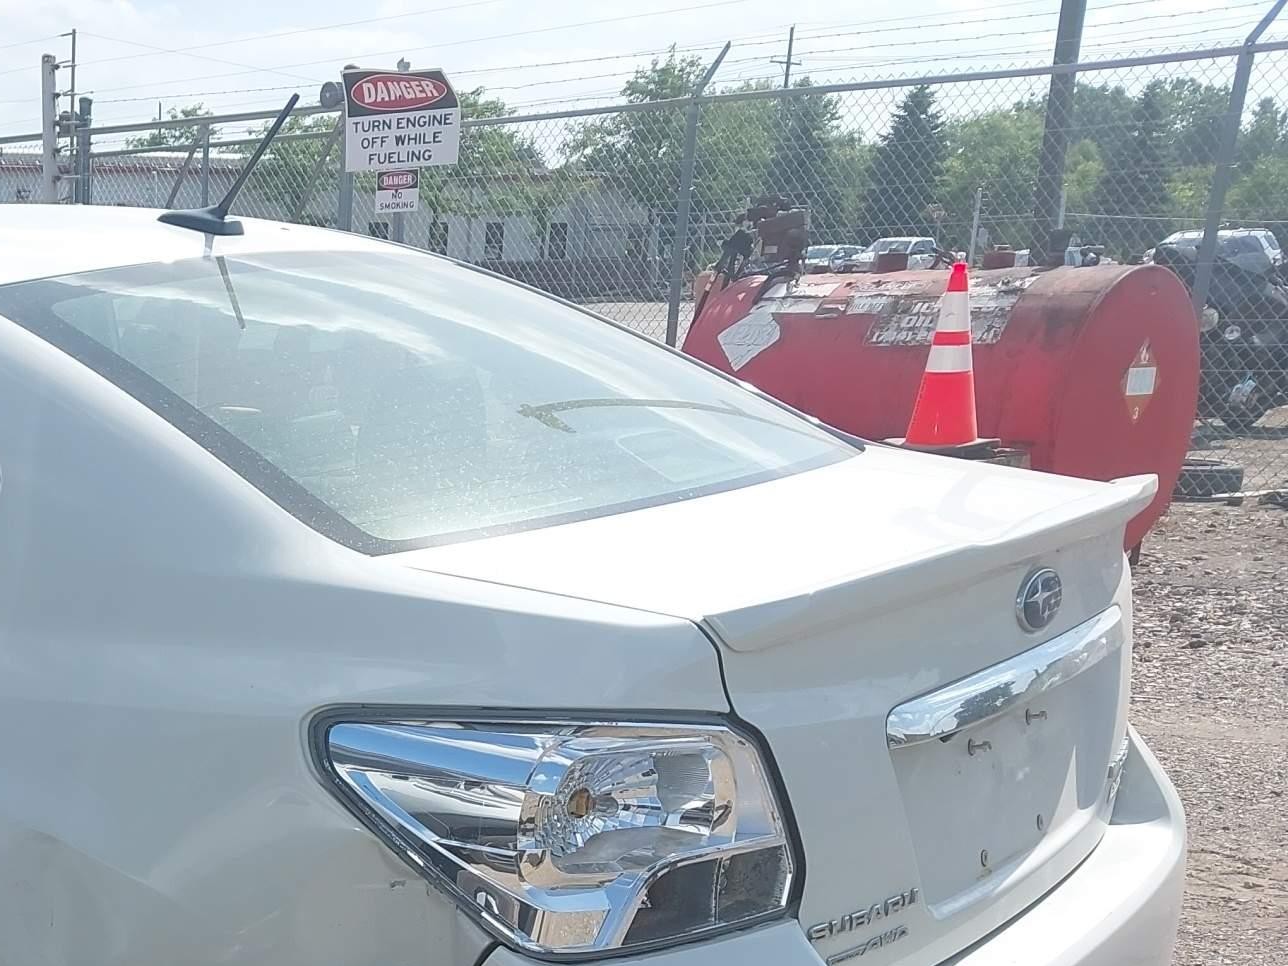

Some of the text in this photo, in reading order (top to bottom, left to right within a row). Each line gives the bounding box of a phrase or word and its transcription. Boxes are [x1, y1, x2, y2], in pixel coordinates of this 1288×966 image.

[362, 80, 439, 104] DANGER
[352, 113, 453, 134] TURN ENGINE
[360, 131, 443, 150] OFF WHILE
[368, 149, 433, 165] FUELING
[383, 174, 413, 186] DANGER
[391, 191, 403, 200] NO
[379, 200, 415, 211] SMOKING
[1132, 406, 1139, 420] 3
[806, 887, 920, 941] SUBARU
